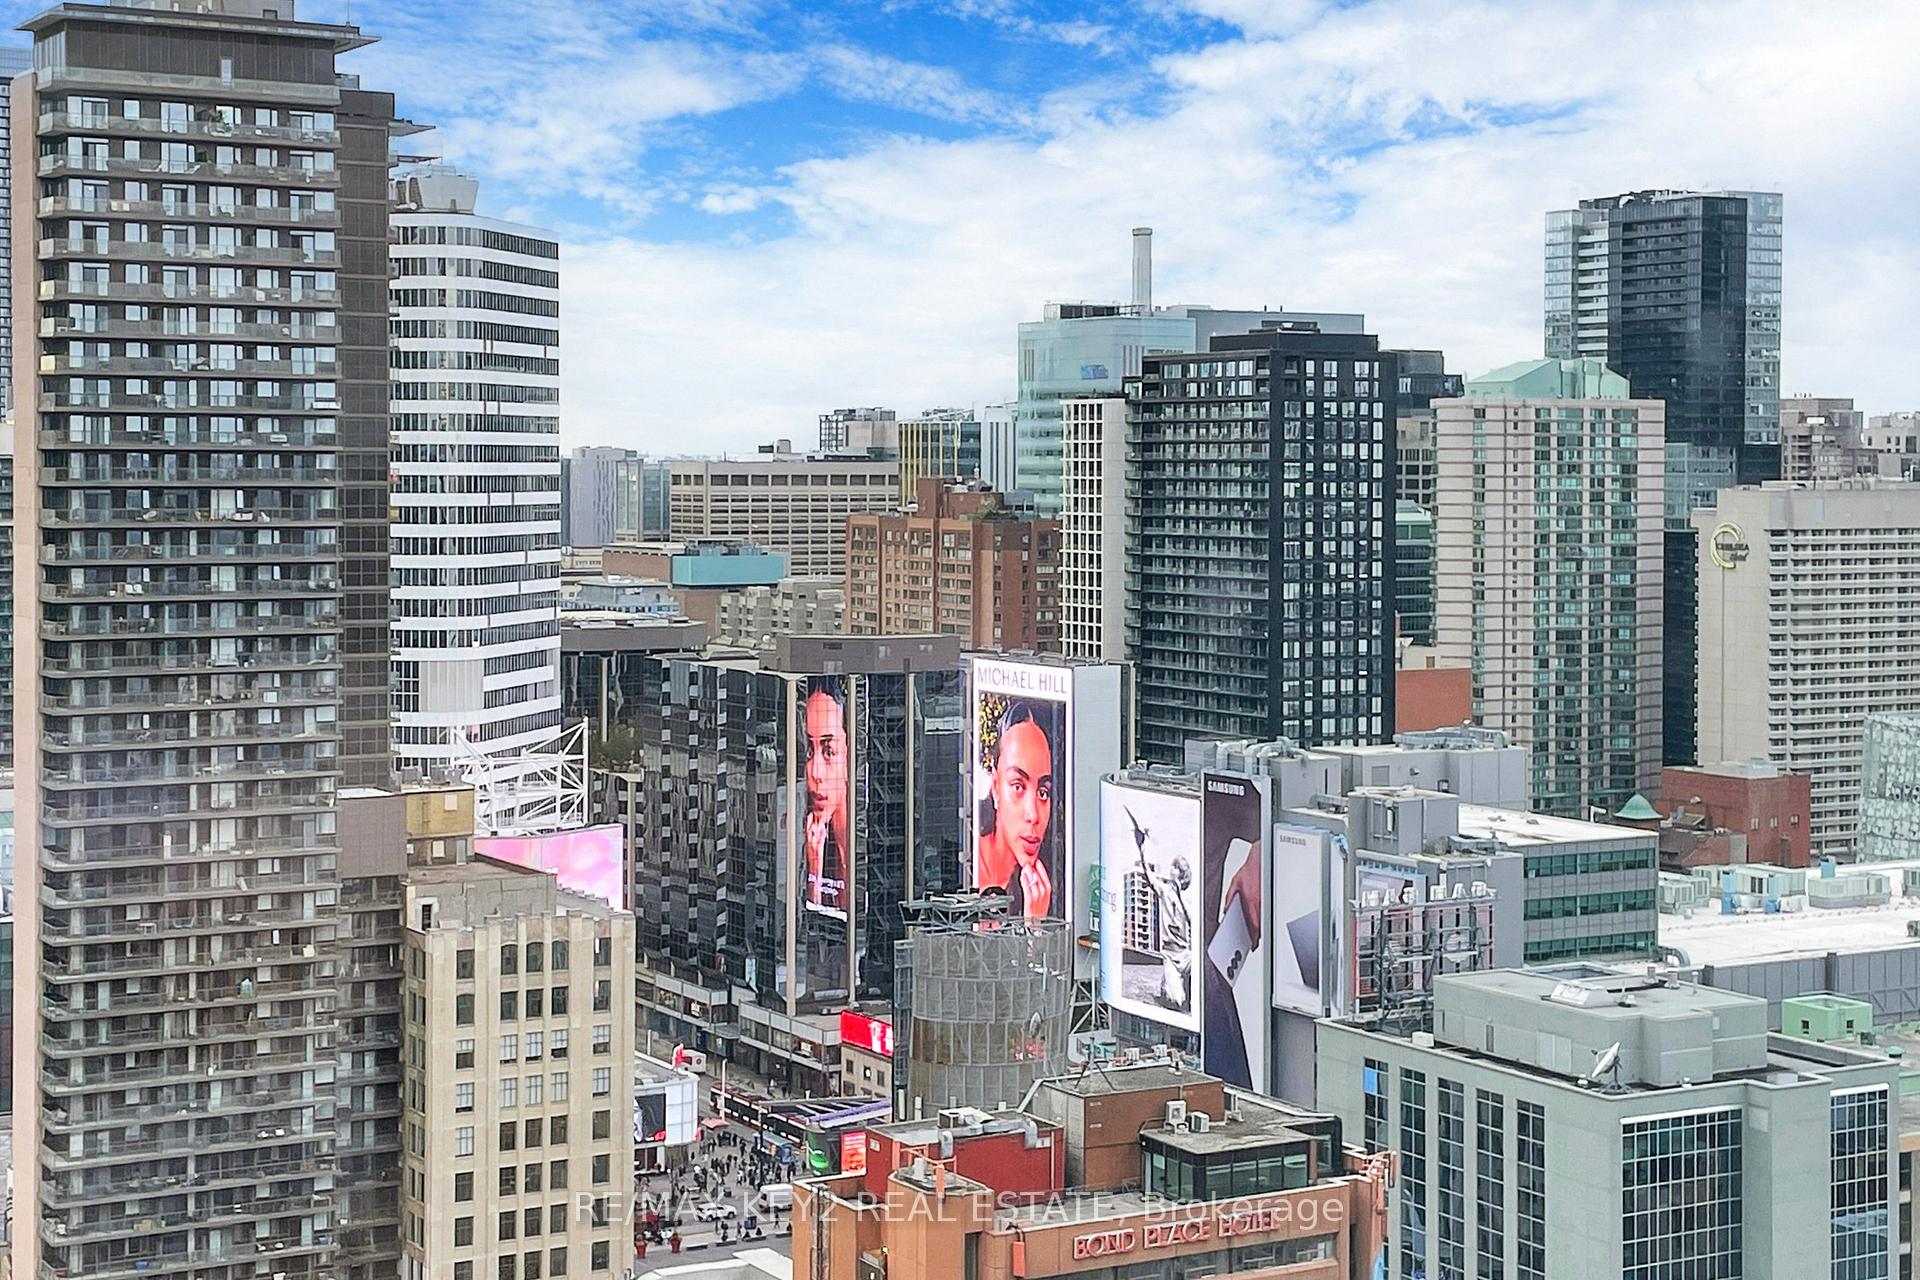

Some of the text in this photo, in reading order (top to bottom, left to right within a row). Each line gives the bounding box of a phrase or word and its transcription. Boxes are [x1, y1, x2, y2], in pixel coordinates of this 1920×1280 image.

[978, 666, 1067, 694] MICHAEL HILL
[1207, 780, 1245, 796] SAMSUNG
[1074, 1206, 1281, 1260] BOND PLACE HOTEL
